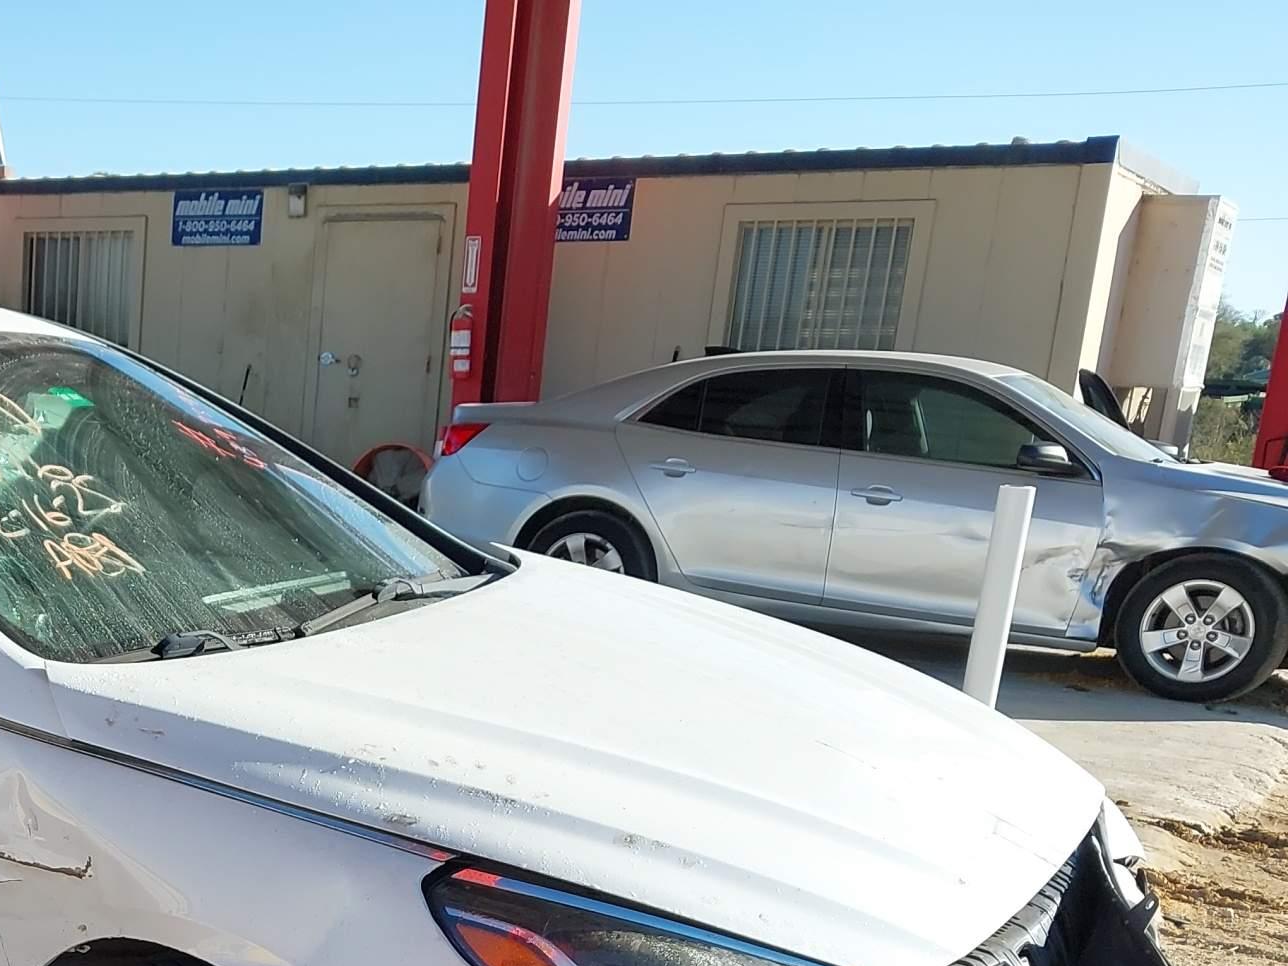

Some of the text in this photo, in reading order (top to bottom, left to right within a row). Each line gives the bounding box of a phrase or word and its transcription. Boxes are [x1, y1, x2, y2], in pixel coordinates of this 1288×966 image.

[559, 182, 632, 209] ile mini
[175, 192, 261, 215] mobile mini
[178, 220, 255, 232] 1-800-950-6464
[181, 233, 250, 244] mobilemini.com
[555, 227, 616, 240] ilemini.com
